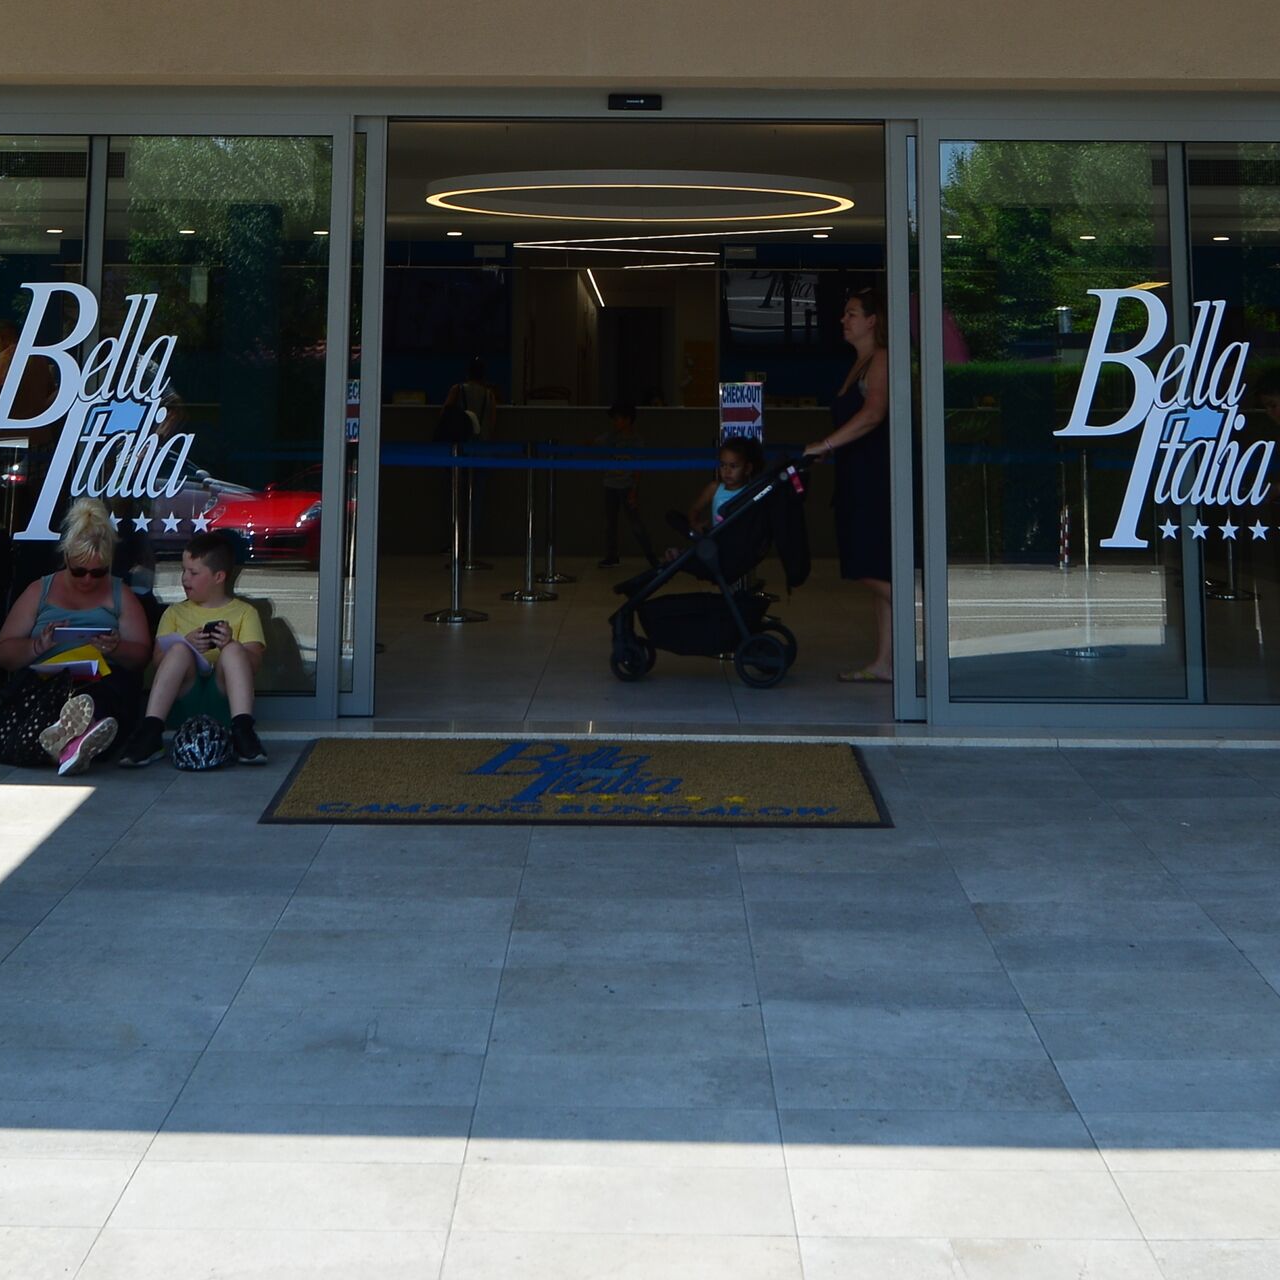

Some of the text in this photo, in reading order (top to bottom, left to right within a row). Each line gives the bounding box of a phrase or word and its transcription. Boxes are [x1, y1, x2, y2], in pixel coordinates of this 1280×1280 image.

[1053, 288, 1250, 436] Bella
[722, 385, 761, 404] CHECK-OUT
[723, 425, 762, 439] CHECKOUT
[13, 398, 195, 540] Italia
[1099, 404, 1275, 548] Italia
[467, 742, 651, 776] Bella
[501, 769, 683, 803] Italia
[558, 804, 839, 816] BUNGALOW
